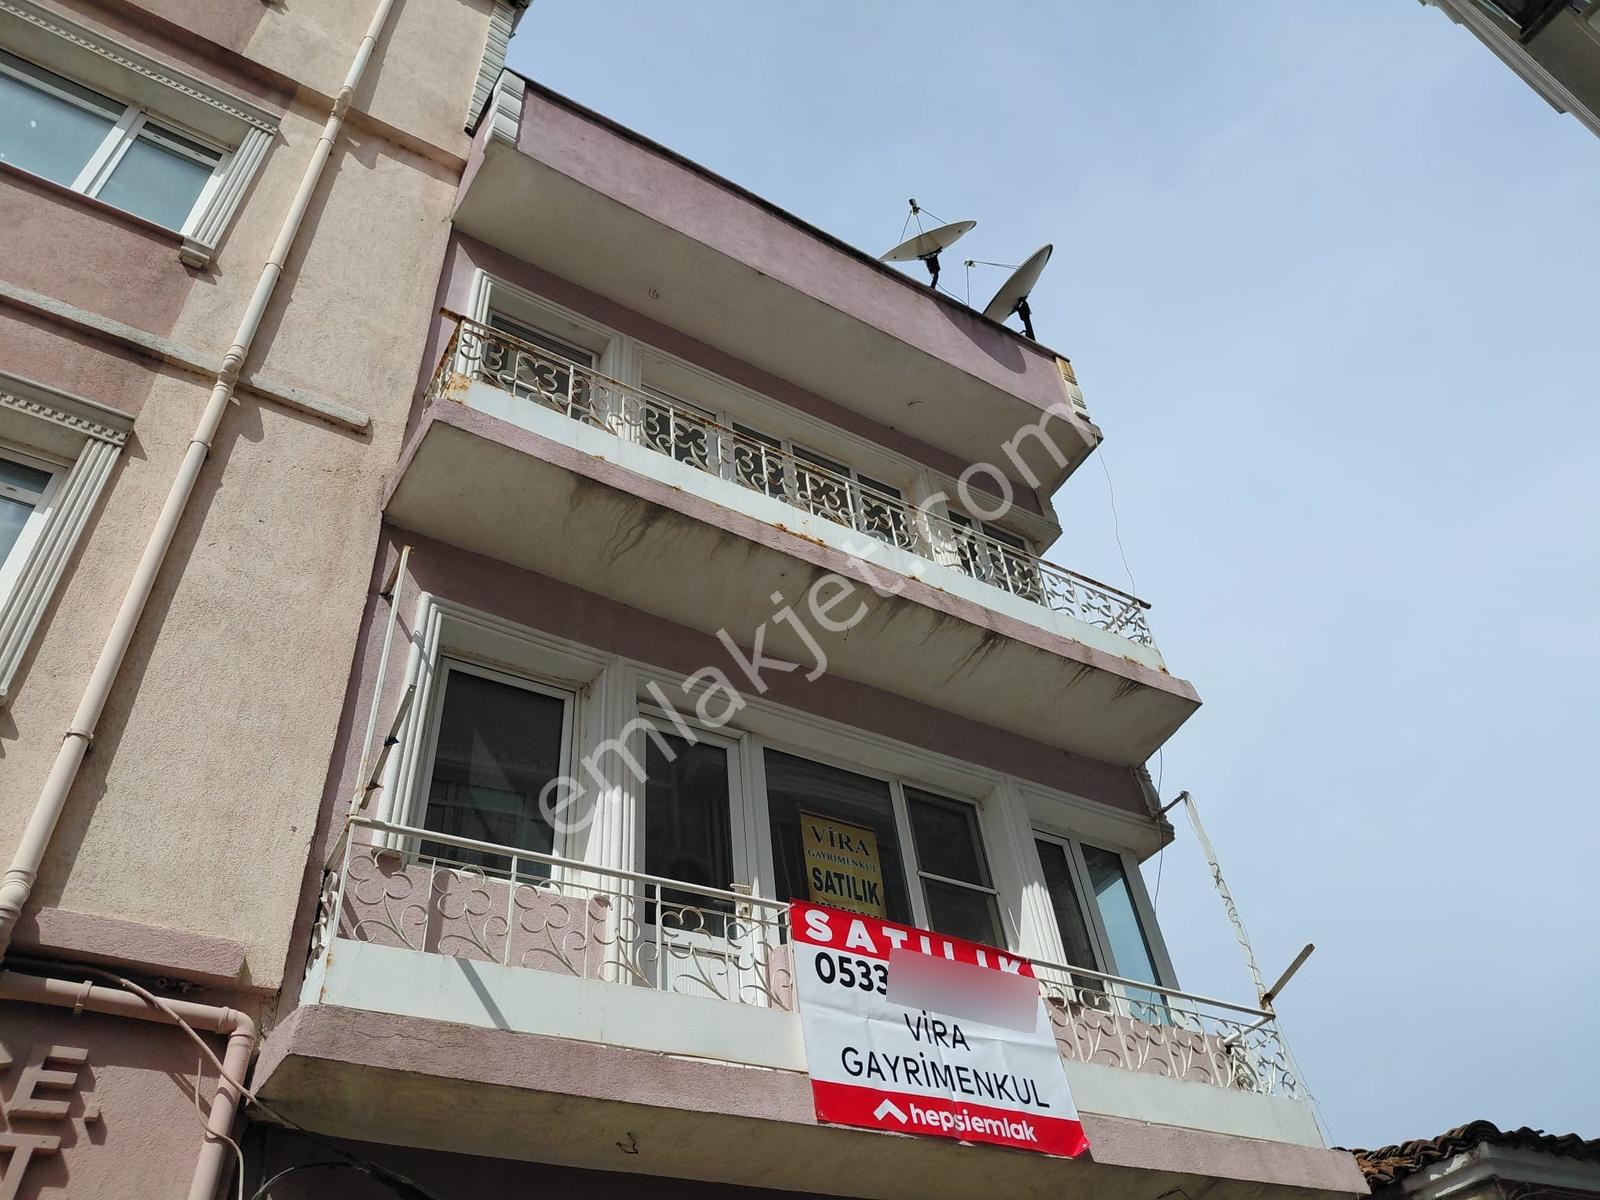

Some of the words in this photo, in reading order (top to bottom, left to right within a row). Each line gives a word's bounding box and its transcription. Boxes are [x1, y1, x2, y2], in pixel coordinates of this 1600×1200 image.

[811, 825, 870, 856] VİRA
[812, 867, 881, 906] SATILIK
[904, 1010, 970, 1051] VİRA
[841, 1047, 1050, 1108] GAYRİMENKUL
[909, 1103, 1038, 1142] hepsiemlak
